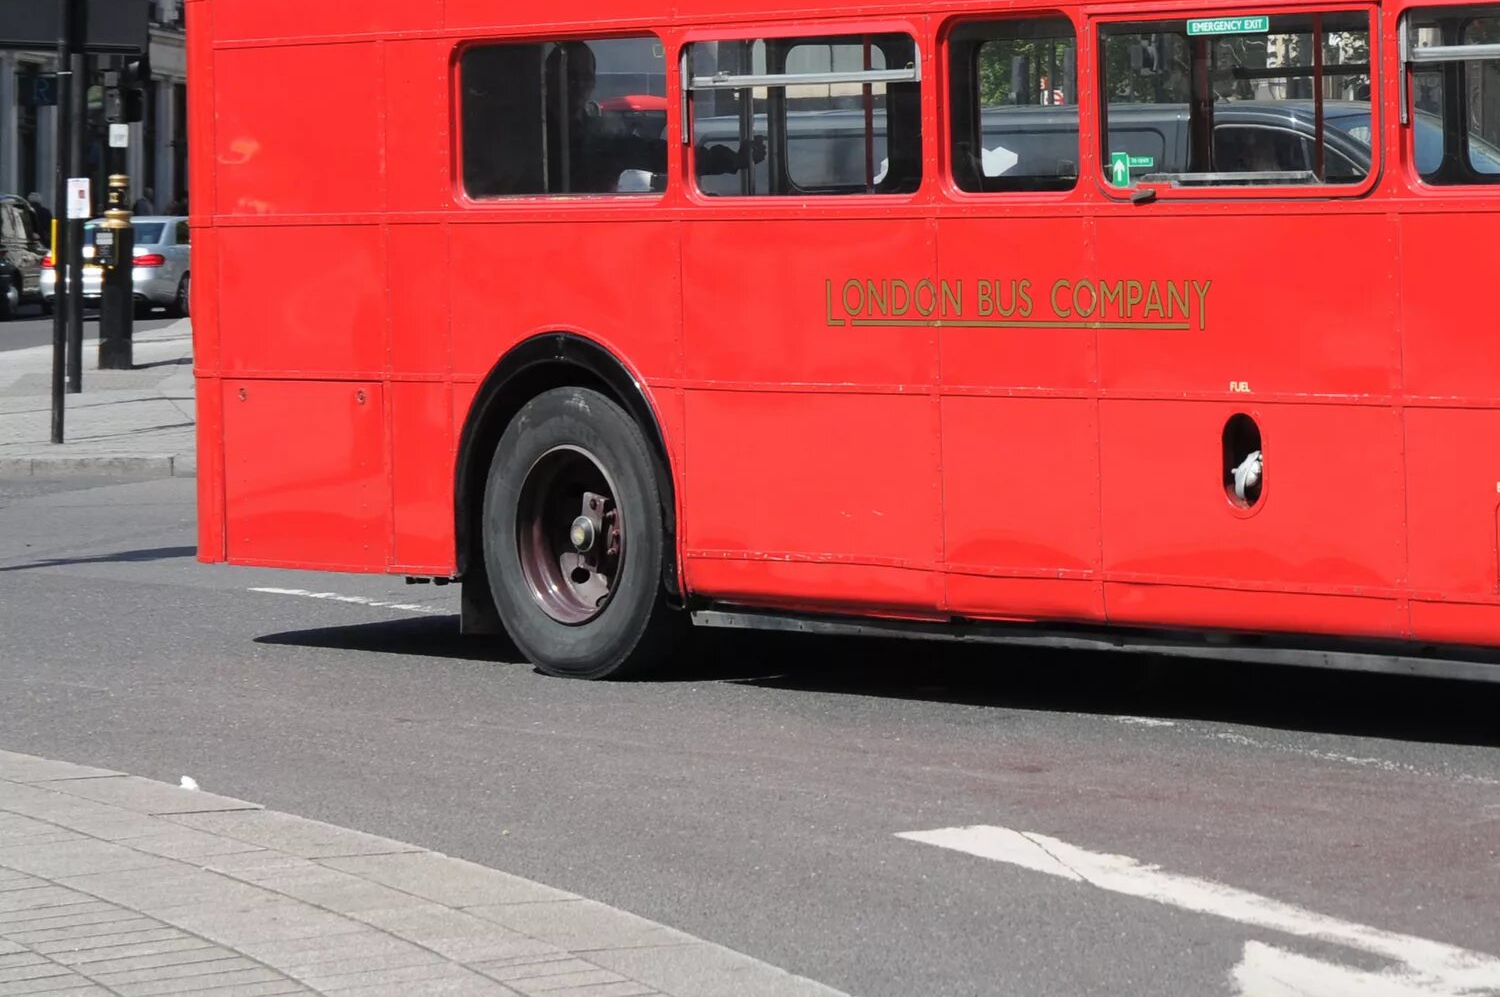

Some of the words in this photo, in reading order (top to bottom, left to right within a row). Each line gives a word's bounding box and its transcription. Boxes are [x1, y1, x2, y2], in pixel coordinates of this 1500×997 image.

[1192, 20, 1242, 32] EMERGENCY
[1243, 19, 1263, 30] EXIT
[825, 278, 963, 326] LONDON
[977, 279, 1034, 318] BUS
[1050, 279, 1212, 331] COMPANY
[1230, 381, 1251, 393] FUEL
